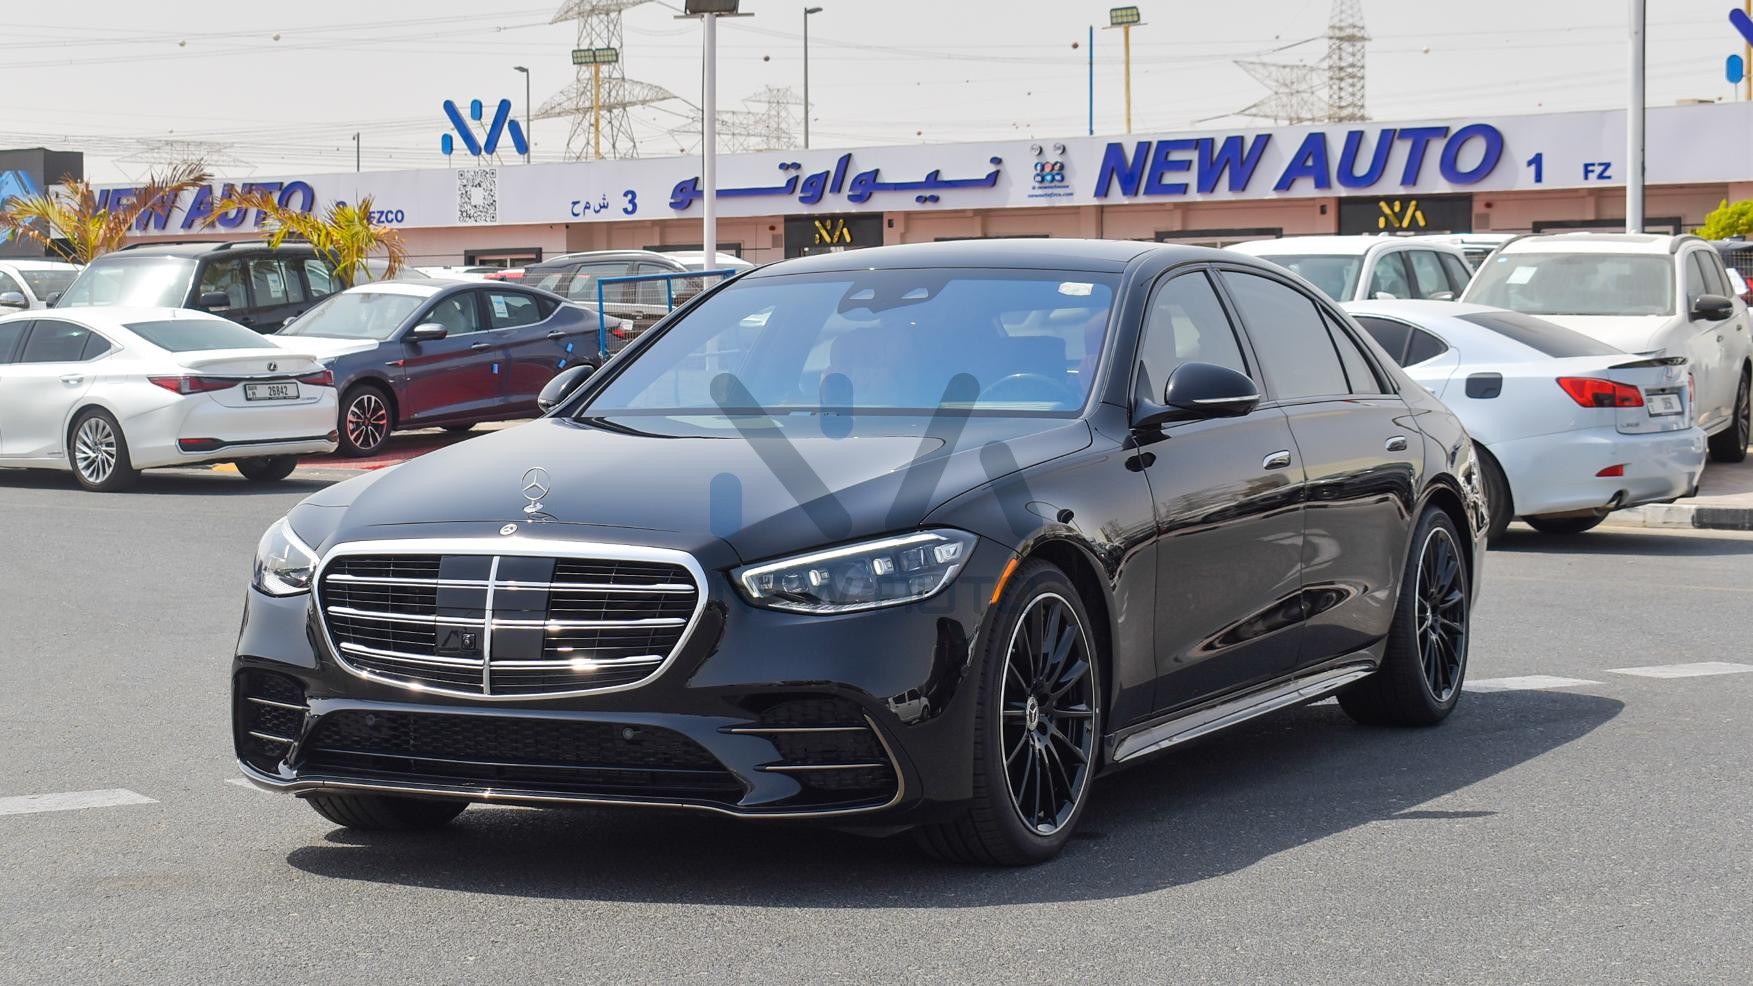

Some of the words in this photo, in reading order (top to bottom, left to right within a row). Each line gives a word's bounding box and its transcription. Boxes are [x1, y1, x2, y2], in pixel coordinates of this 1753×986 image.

[1093, 133, 1272, 198] NEW
[1272, 122, 1505, 192] AUTO
[1526, 152, 1543, 184] 1
[1582, 162, 1613, 181] FZ
[180, 181, 315, 231] AUTO
[622, 189, 638, 216] 3
[268, 385, 288, 397] 26842
